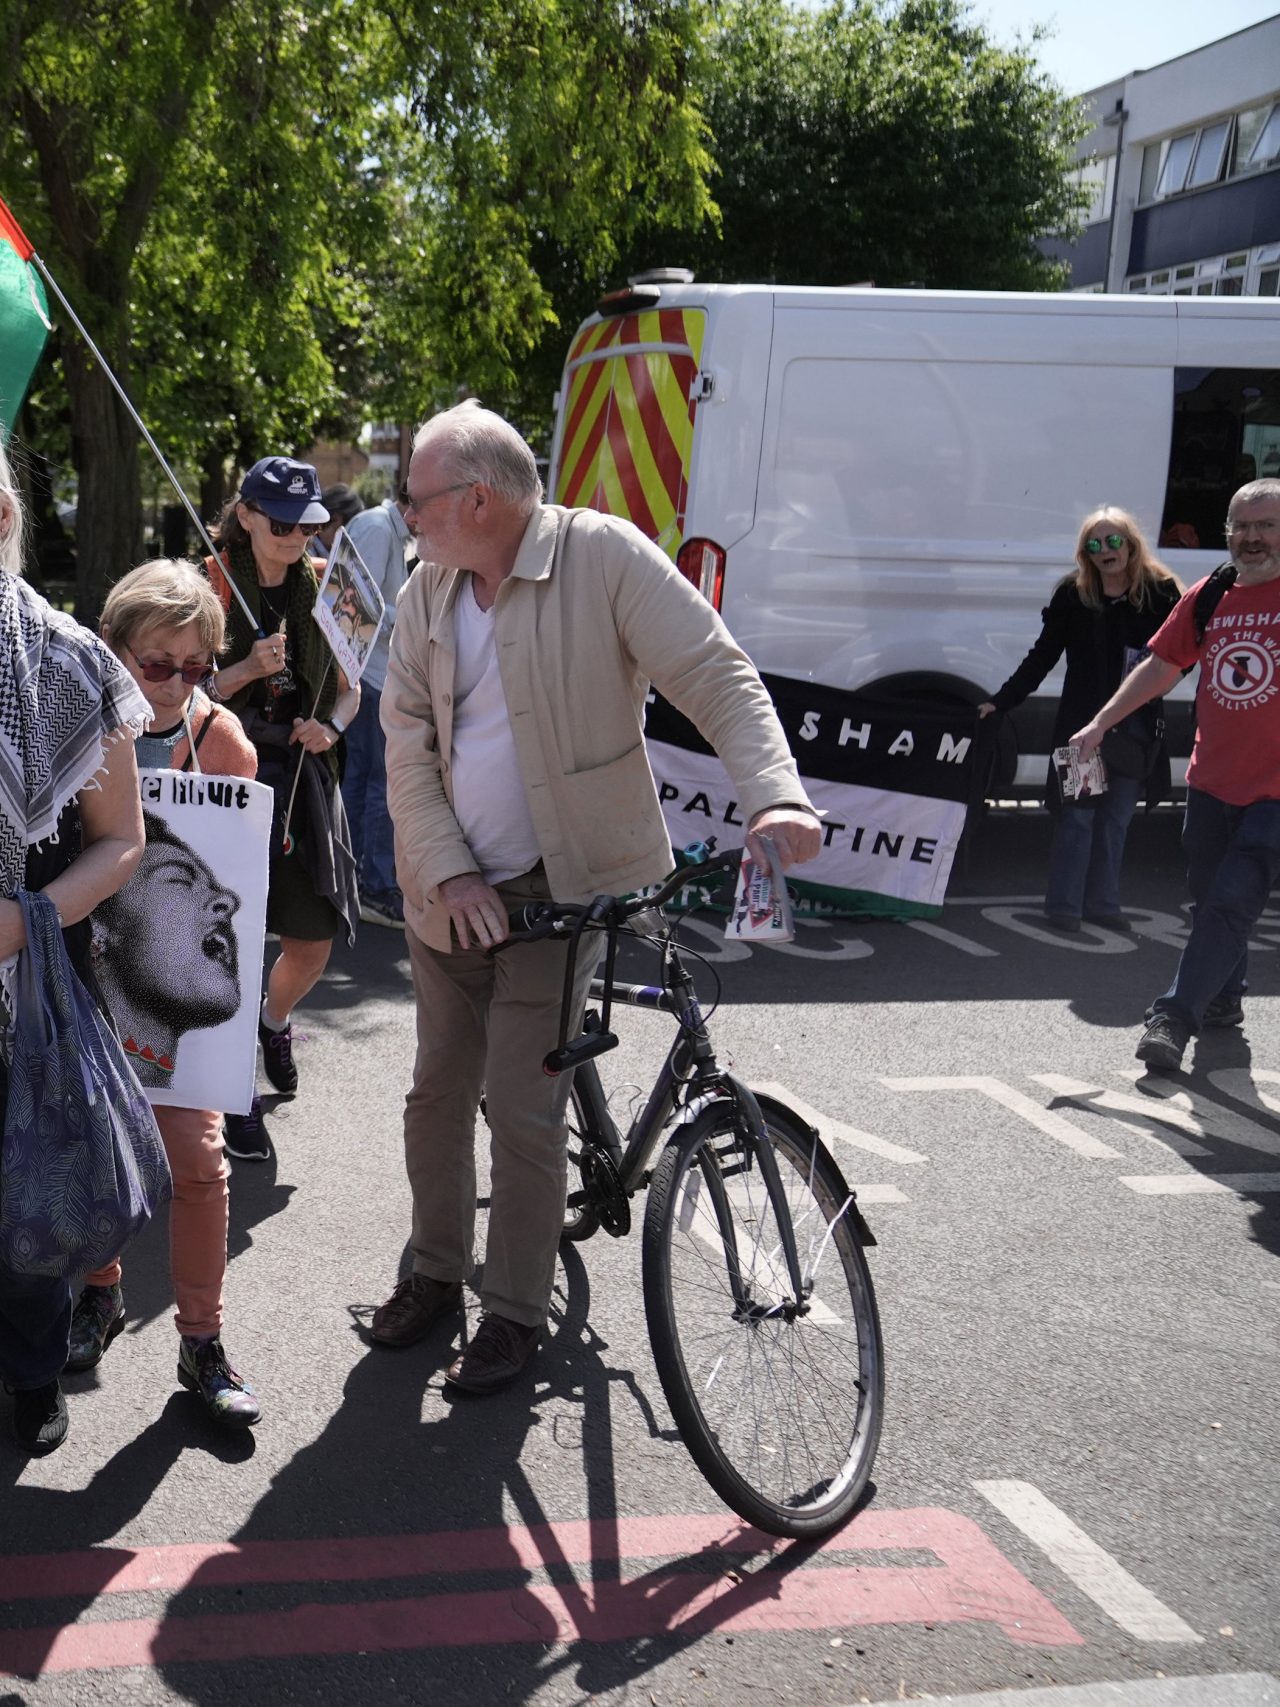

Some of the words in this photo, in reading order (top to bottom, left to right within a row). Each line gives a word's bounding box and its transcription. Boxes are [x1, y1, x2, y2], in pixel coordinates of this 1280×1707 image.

[1233, 630, 1262, 641] THE
[1206, 684, 1279, 711] COALITION
[660, 782, 938, 864] PALTINE
